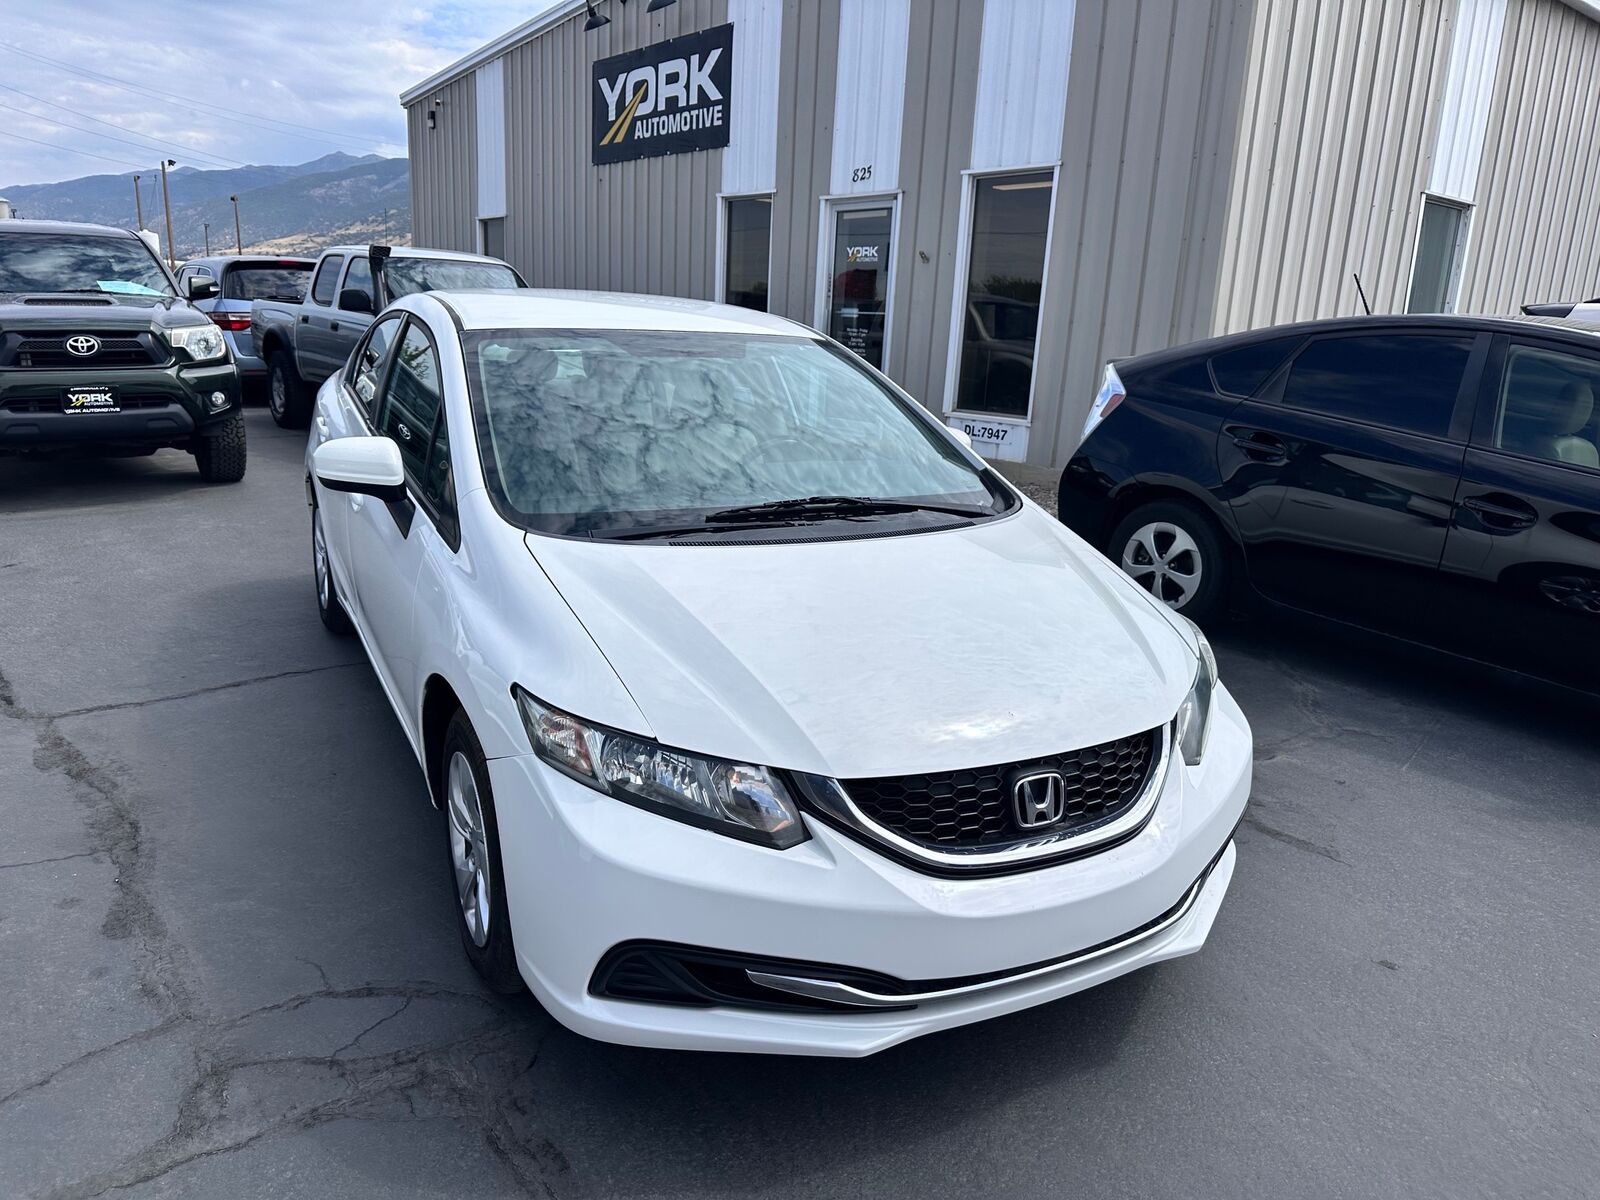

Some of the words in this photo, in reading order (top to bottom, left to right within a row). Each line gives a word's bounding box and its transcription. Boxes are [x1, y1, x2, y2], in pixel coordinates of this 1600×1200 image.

[598, 47, 723, 122] YORK
[634, 105, 723, 140] AUTOMOTIVE
[852, 165, 872, 182] 825
[846, 246, 878, 257] YORK
[67, 393, 113, 402] YORK
[964, 424, 1008, 440] DL:7947
